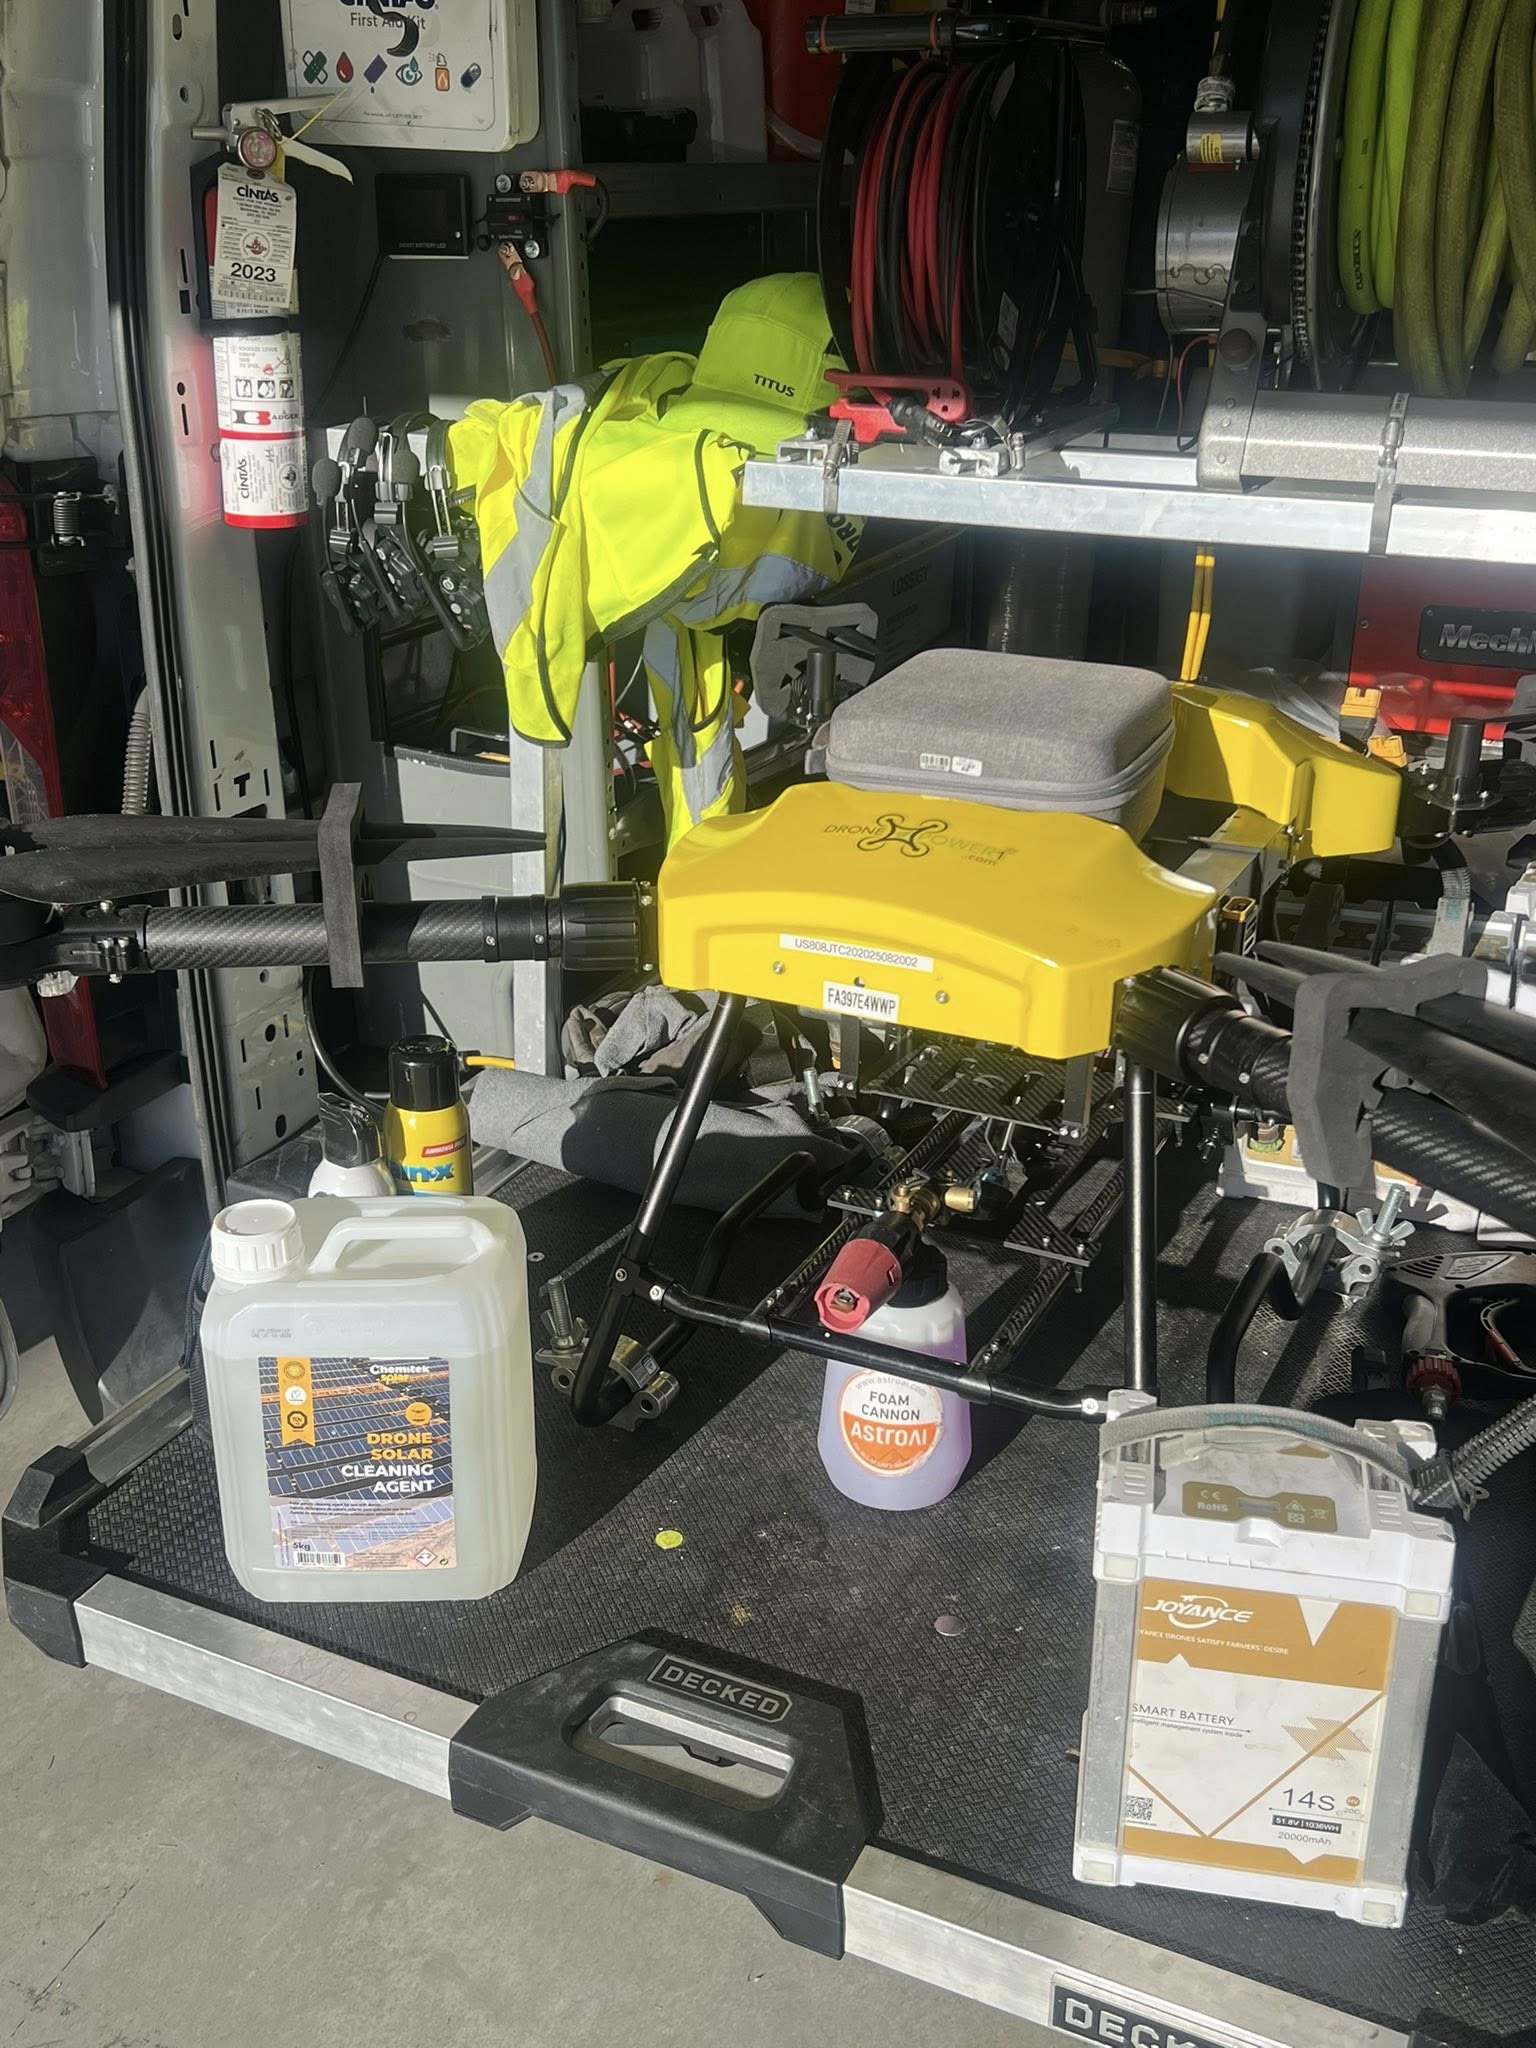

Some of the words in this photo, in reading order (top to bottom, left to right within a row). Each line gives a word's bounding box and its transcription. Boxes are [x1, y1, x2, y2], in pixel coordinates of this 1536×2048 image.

[350, 12, 378, 28] First
[230, 262, 277, 283] 2023
[753, 373, 795, 397] TITUS
[823, 824, 887, 836] DRONE
[827, 987, 896, 1015] FA397E4WWP
[369, 1364, 430, 1374] Chemitek
[869, 1391, 910, 1406] FOAM
[861, 1406, 920, 1421] CANNON
[367, 1433, 433, 1444] DRONE
[371, 1448, 433, 1460] SOLAR
[341, 1464, 434, 1477] CLEANING
[373, 1480, 435, 1493] AGENT
[1197, 1502, 1229, 1513] RoHS
[292, 1542, 311, 1552] 5kg
[1144, 1599, 1254, 1624] JOYANCE
[1165, 1632, 1195, 1643] DRONES
[661, 1665, 780, 1714] DECKED
[1132, 1703, 1176, 1718] SMART
[1179, 1710, 1235, 1726] BATTERY
[1283, 1787, 1335, 1812] 14S
[1343, 1807, 1361, 1815] 20C
[1278, 1831, 1332, 1846] 20000mAh
